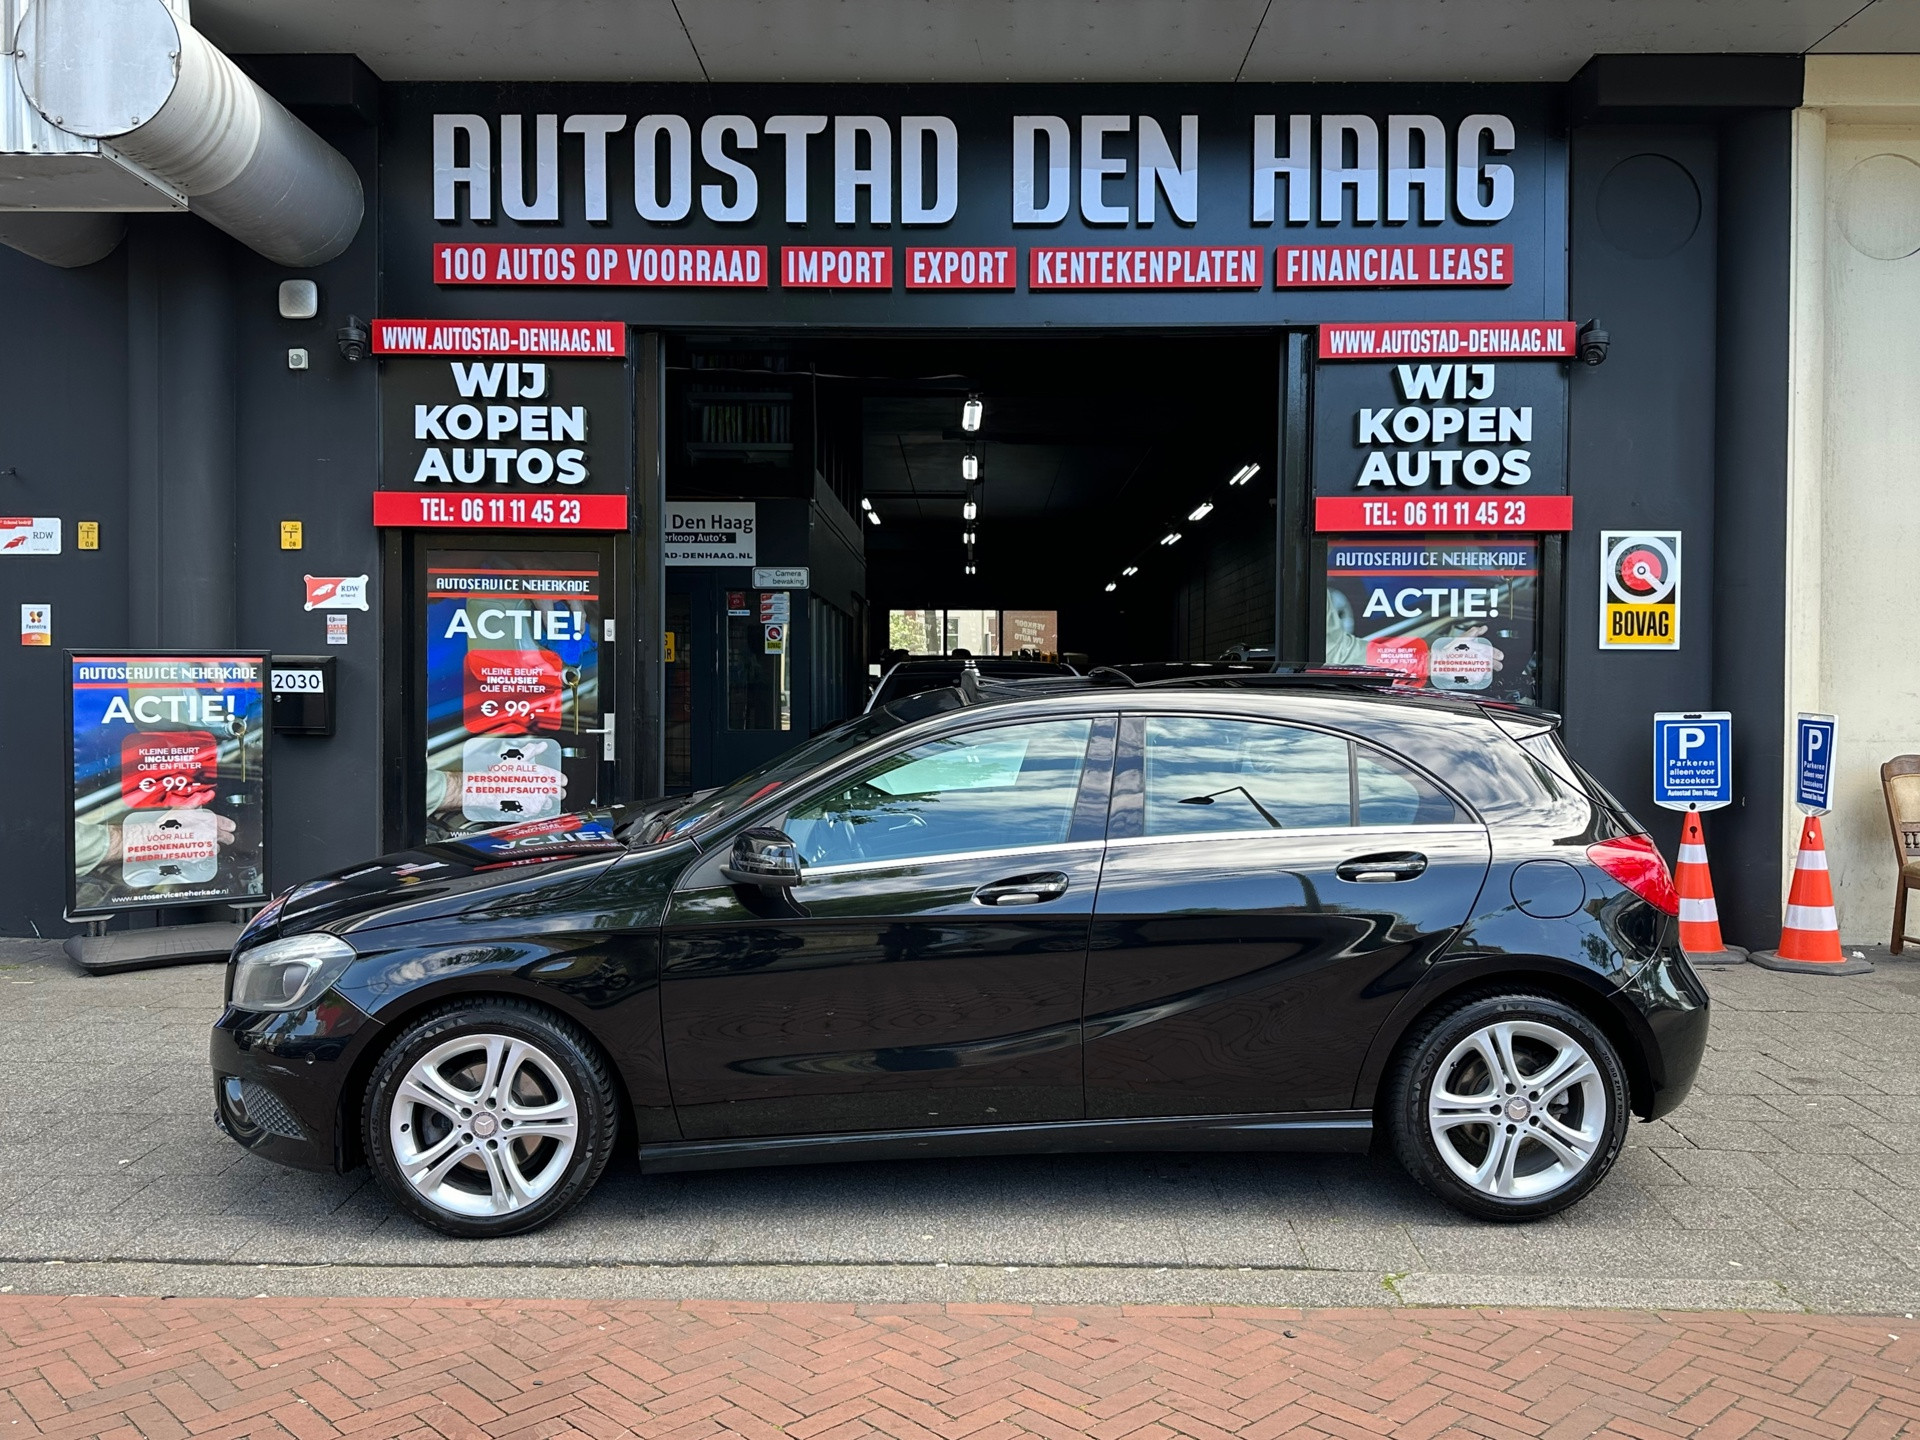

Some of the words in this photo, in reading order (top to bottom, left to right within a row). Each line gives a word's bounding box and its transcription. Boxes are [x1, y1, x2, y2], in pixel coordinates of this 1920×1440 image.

[433, 113, 959, 224] AUTOSTAD
[1012, 114, 1199, 224] DEN
[1252, 114, 1516, 222] HAAG
[441, 248, 486, 281] 100
[495, 249, 577, 281] AUTOS
[586, 249, 619, 282] OP
[626, 249, 761, 283] VOORRAAD
[787, 251, 886, 284] IMPORT
[913, 250, 1009, 284] EXPORT
[1037, 251, 1257, 284] KENTEKENPLATEN
[1286, 248, 1419, 283] FINANCIAL
[1428, 248, 1504, 281] LEASE
[381, 325, 615, 353] WWW.AUTOSTAD-DENHAAG.NL
[1330, 328, 1566, 354] WWW.AUTOSTAD-DENHAAG.NL
[450, 362, 547, 398] WIJ
[1398, 364, 1495, 399] WIJ
[414, 405, 587, 443] KOPEN
[1359, 406, 1533, 443] KOPEN
[413, 447, 587, 485] AUTOS
[1357, 449, 1532, 487] AUTOS
[420, 498, 455, 523] TEL:
[461, 498, 484, 523] 06
[488, 499, 505, 523] 11
[508, 499, 527, 523] 11
[530, 500, 555, 524] 45
[558, 500, 581, 524] 23
[1363, 502, 1397, 526] TEL:
[1404, 502, 1427, 525] 06
[1432, 502, 1448, 525] 11
[1453, 502, 1469, 525] 11
[1475, 502, 1498, 525] 45
[1504, 501, 1526, 525] 23
[672, 514, 706, 530] Den
[711, 514, 754, 534] Haag
[697, 533, 727, 543] Auto's
[1335, 551, 1439, 567] AUTOSERVICE
[1441, 551, 1527, 567] NEHERKADE
[436, 578, 520, 591] AUTOSERVICE
[522, 579, 590, 592] NEHERKADE
[1362, 588, 1500, 618] ACTIE!
[444, 608, 583, 642] ACTIE!
[1612, 610, 1670, 637] BOVAG
[79, 666, 178, 680] AUTOSERVICE
[180, 666, 258, 680] NEHERKADE
[273, 674, 320, 689] 2030
[481, 668, 512, 676] KLEINE
[514, 668, 544, 676] BEURT
[487, 676, 539, 684] INCLUSIEF
[480, 684, 501, 692] OLIE
[502, 684, 515, 692] EN
[516, 685, 546, 693] FILTER
[101, 695, 236, 724] ACTIE!
[480, 700, 499, 717] €
[504, 700, 545, 719] 99,-
[138, 748, 170, 756] KLEINE
[171, 747, 200, 755] BEURT
[144, 755, 195, 763] INCLUSIEF
[137, 763, 159, 771] OLIE
[173, 762, 202, 770] FILTER
[487, 765, 515, 773] VOOR
[1669, 759, 1715, 767] Parkeren
[1669, 768, 1694, 776] alleen
[138, 777, 157, 793] €
[162, 776, 201, 794] 99,-
[467, 775, 557, 784] PERSONENAUTO'S
[475, 786, 558, 795] BEDRIJFSAUTO'S
[146, 833, 172, 842] VOOR
[173, 832, 195, 840] ALLE
[127, 841, 213, 853] PERSONENAUTO'S
[135, 850, 215, 863] BEDRIJFSAUTO'S
[111, 888, 229, 903] www.autoserviceneherkade.nl
